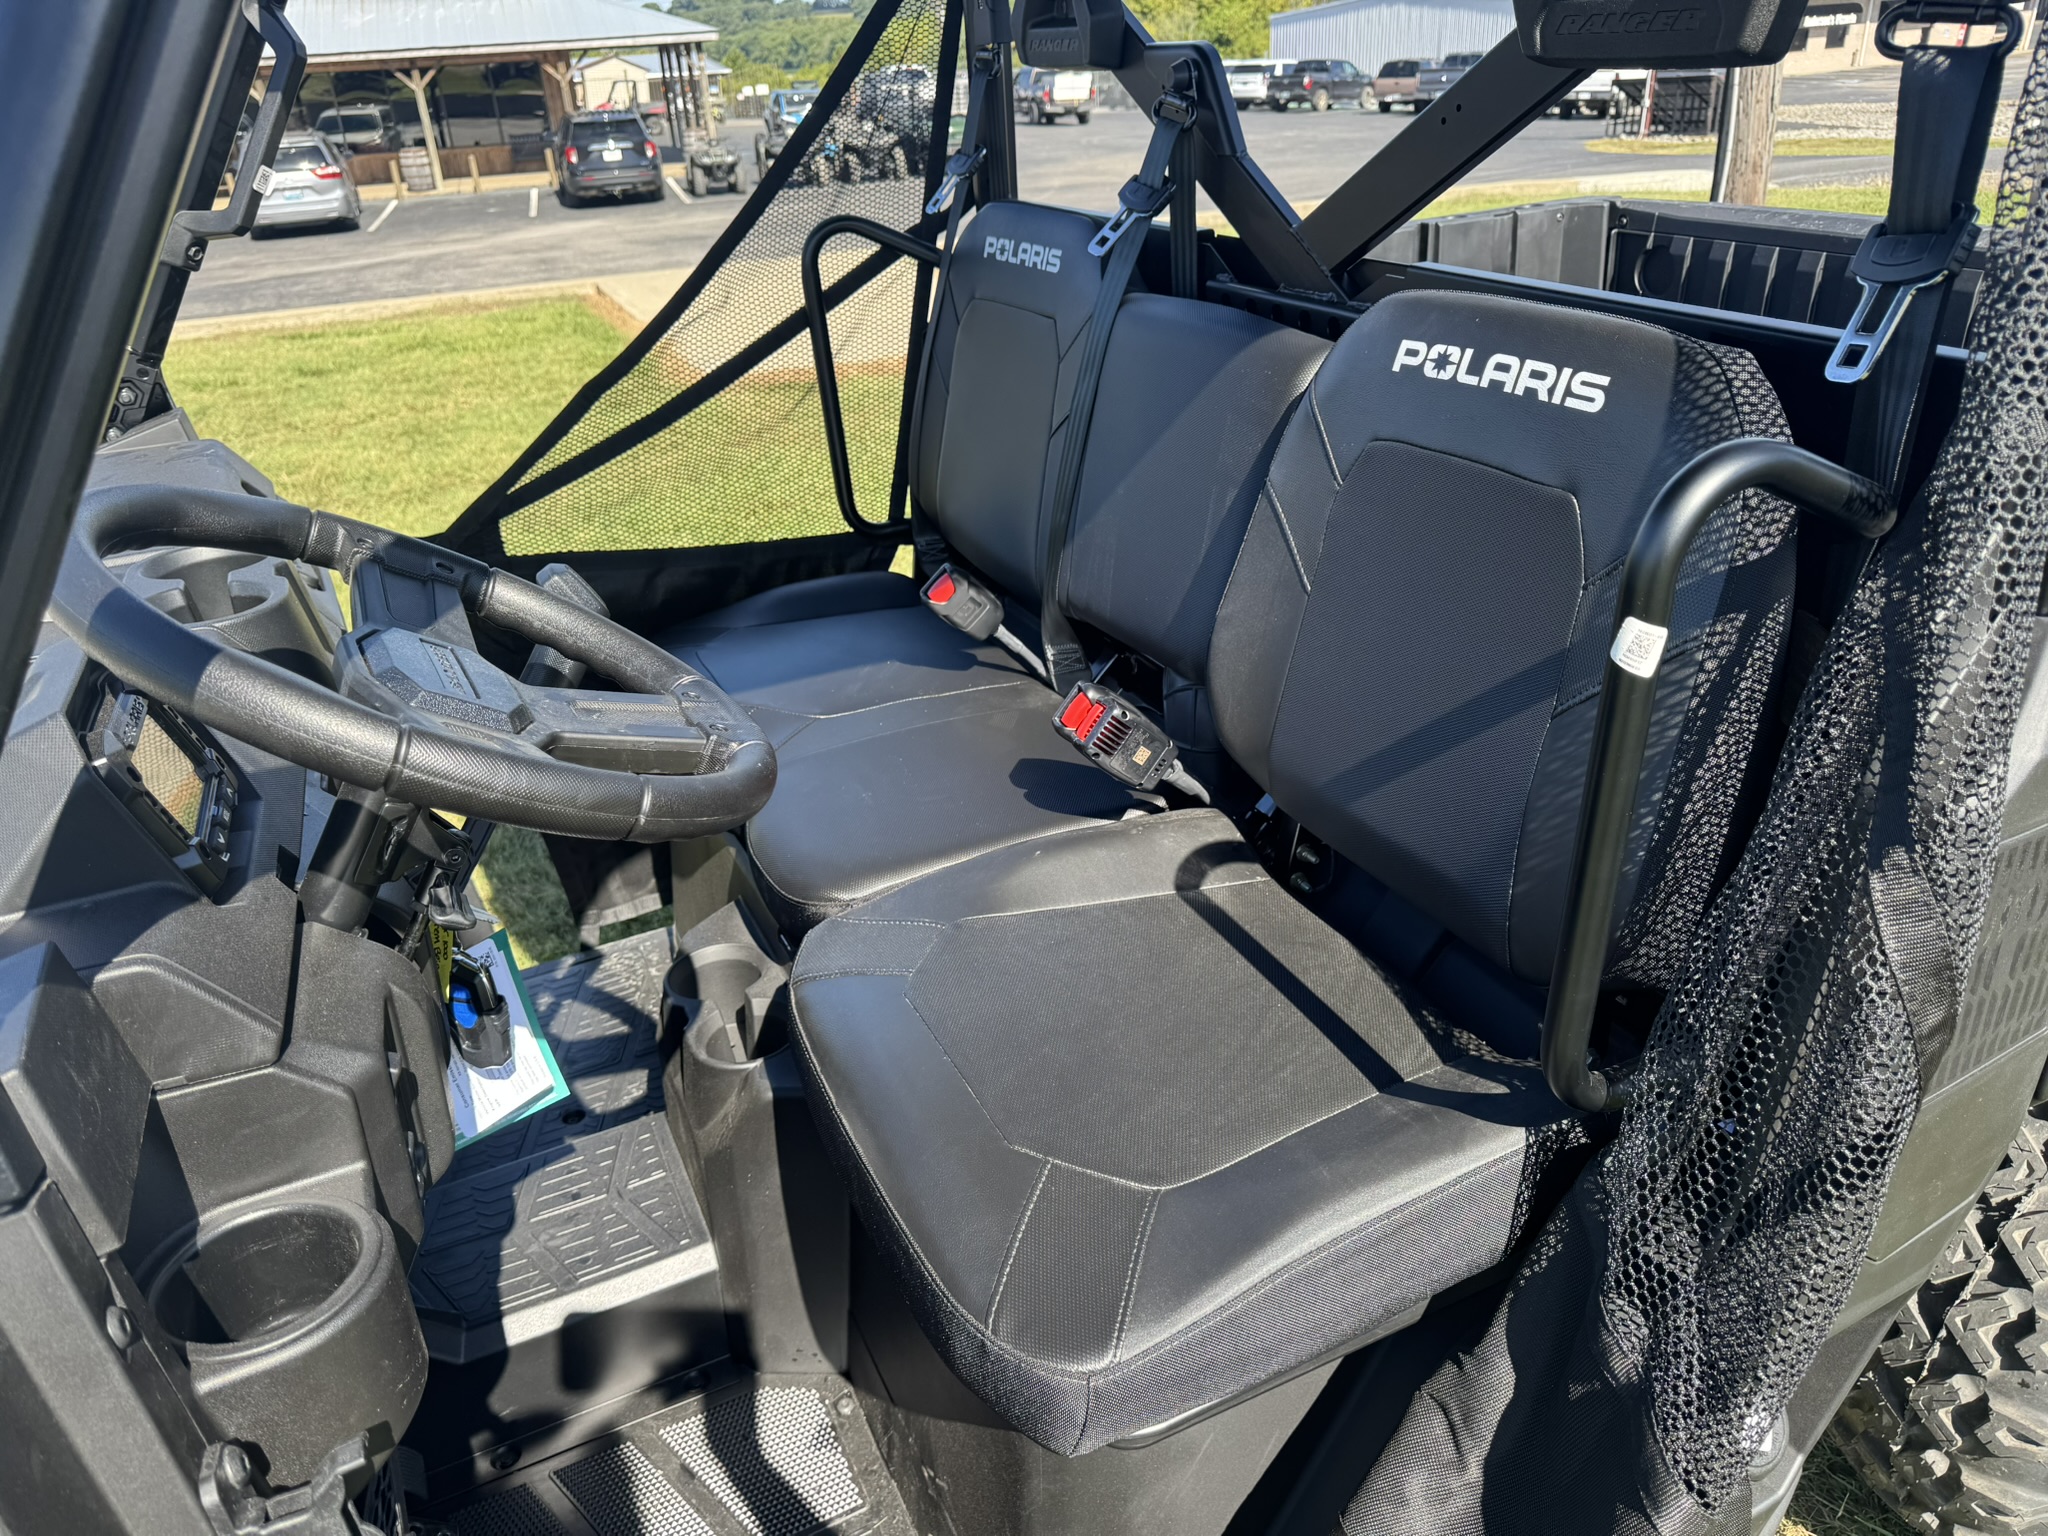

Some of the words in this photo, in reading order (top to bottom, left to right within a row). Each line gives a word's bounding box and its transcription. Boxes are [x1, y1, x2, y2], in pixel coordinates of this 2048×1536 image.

[1556, 8, 1704, 35] RANGER
[1029, 38, 1080, 52] RANGER
[983, 235, 1063, 274] POLARIS
[1391, 339, 1612, 413] POLARIS
